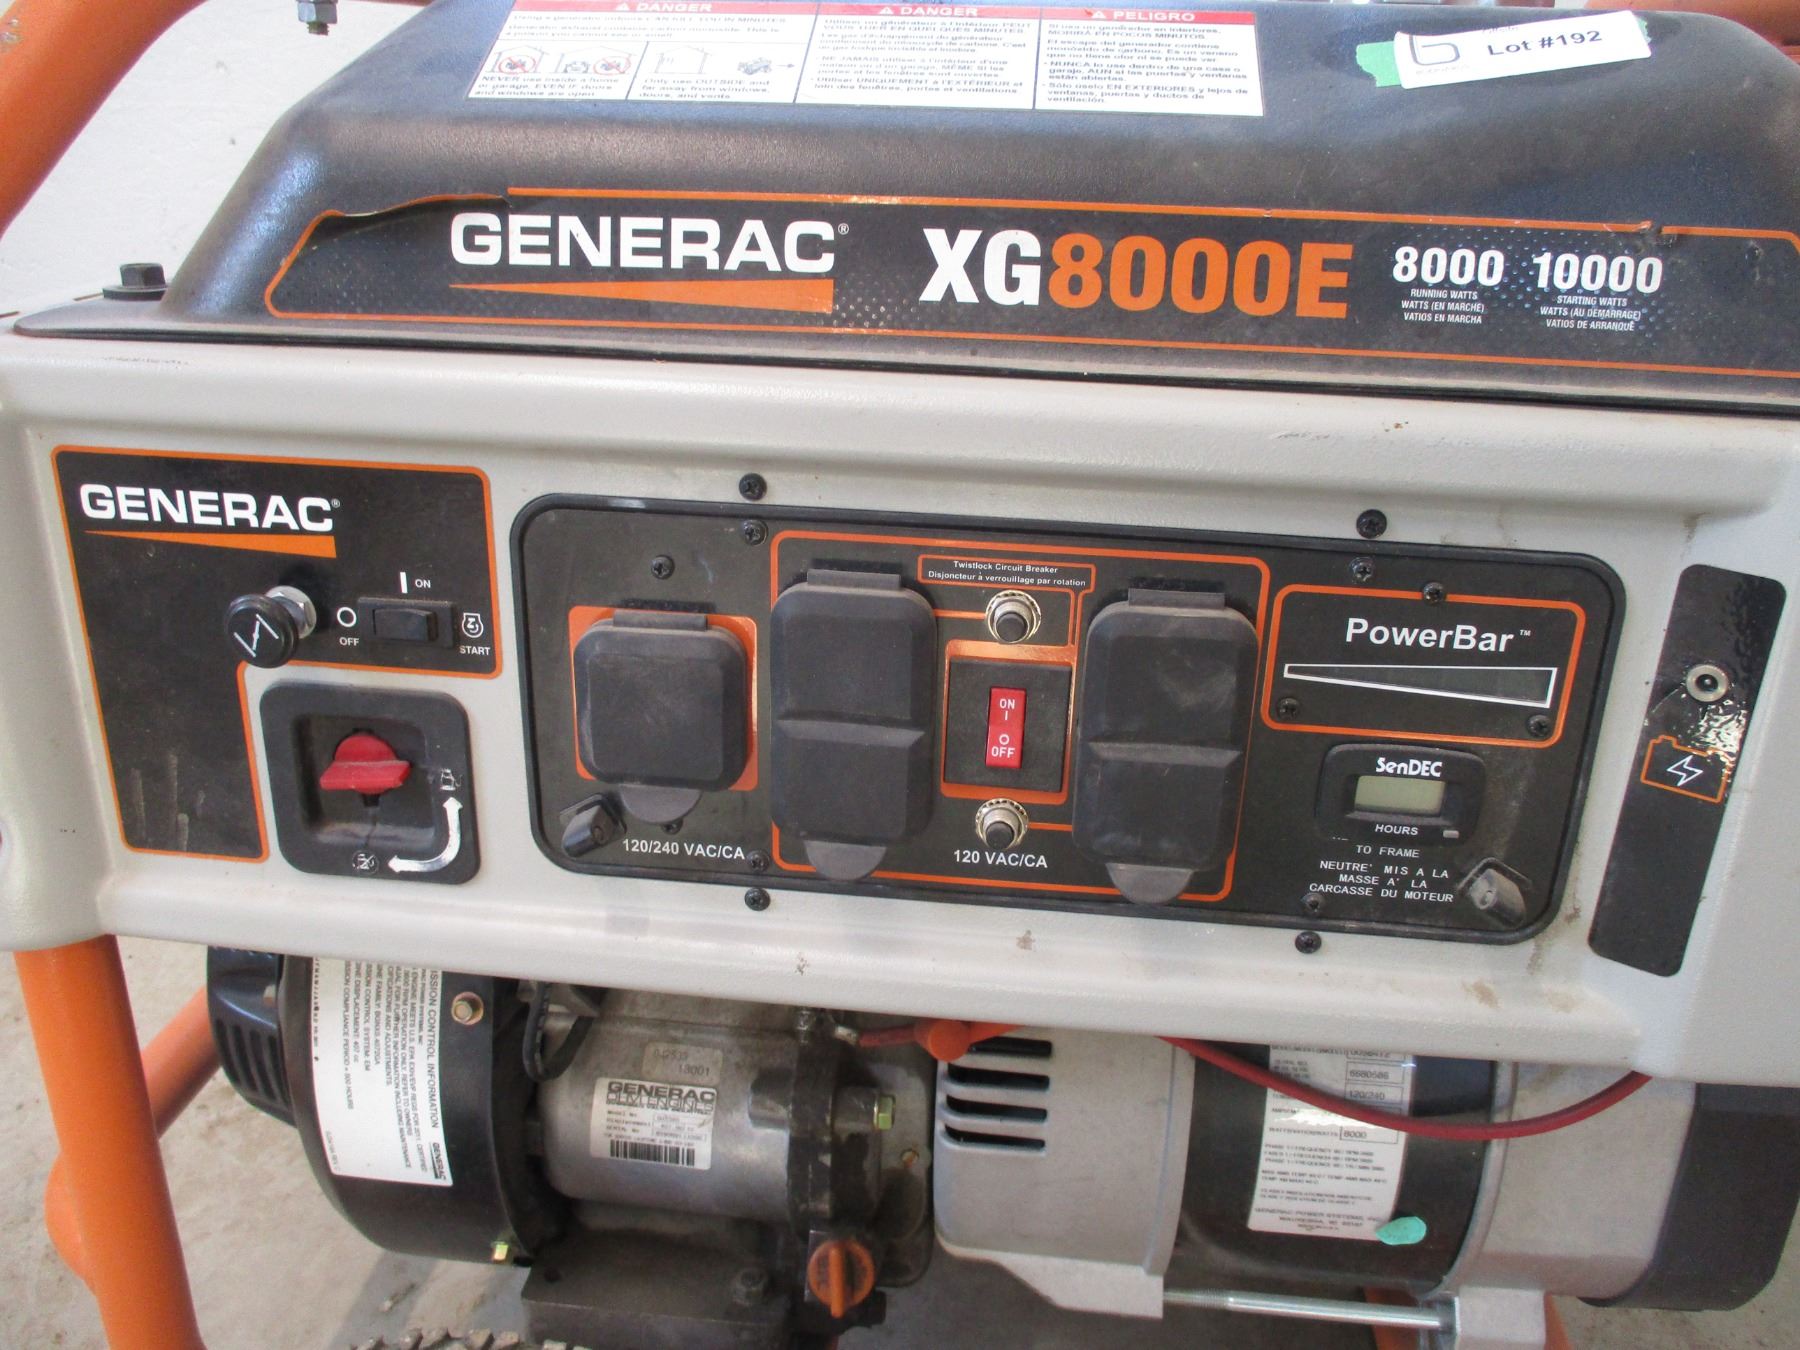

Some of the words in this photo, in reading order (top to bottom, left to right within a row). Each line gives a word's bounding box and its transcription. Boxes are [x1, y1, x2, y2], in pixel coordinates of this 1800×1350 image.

[636, 3, 713, 12] DANGER
[900, 7, 978, 16] DANGER
[1113, 12, 1195, 22] PELIGRO
[1487, 40, 1531, 56] Lot
[1539, 30, 1602, 50] #192
[919, 228, 1354, 319] XG8000E
[1392, 246, 1504, 287] 8000
[1532, 251, 1663, 293] 10000
[1410, 288, 1448, 300] RUNNING
[1449, 290, 1478, 301] WATTS
[1557, 295, 1598, 306] STARTING
[1599, 297, 1627, 307] WATTS
[1401, 300, 1430, 311] WATTS
[1431, 301, 1446, 312] (EN
[1540, 306, 1568, 317] WATTS
[1570, 307, 1586, 318] (AU
[1404, 311, 1433, 322] VATIOS
[1434, 313, 1445, 322] EN
[1446, 313, 1482, 324] MARCHA
[1546, 318, 1575, 329] VATIOS
[1577, 320, 1588, 329] DE
[953, 560, 992, 570] Twistlock
[995, 563, 1023, 572] Circuit
[1025, 564, 1058, 573] Breaker
[414, 578, 431, 589] ON
[928, 570, 976, 581] Disjoncteur
[985, 574, 1035, 584] verrouillage
[1037, 577, 1050, 586] par
[1053, 578, 1086, 587] rotation
[339, 637, 360, 647] OFF
[459, 644, 490, 656] START
[999, 698, 1015, 710] ON
[991, 746, 1015, 758] OFF
[1375, 757, 1443, 778] SenDEC
[1374, 824, 1419, 836] HOURS
[623, 838, 679, 855] 120/240
[684, 843, 745, 860] VAC/CA
[1356, 844, 1372, 854] TO
[1378, 847, 1420, 858] FRAME
[953, 850, 980, 864] 120
[984, 851, 1048, 868] VAC/CA
[1383, 866, 1408, 875] MIS
[1416, 868, 1424, 876] A
[1432, 869, 1449, 879] LA
[1339, 874, 1379, 885] MASSE
[1411, 879, 1427, 889] LA
[1309, 883, 1373, 897] CARCASSE
[1381, 889, 1397, 898] DU
[1405, 890, 1454, 902] MOTEUR
[410, 971, 418, 999] ENGINE
[428, 970, 438, 1006] ISSION
[385, 1014, 393, 1030] AND
[393, 1003, 401, 1038] FURTHER
[409, 1002, 417, 1028] MEETS
[401, 1008, 409, 1050] OPERATION
[427, 1009, 437, 1060] CONTROL
[393, 1040, 401, 1089] INFORMATION
[346, 1086, 354, 1109] HOURS
[427, 1063, 439, 1128] INFORMATION
[608, 1081, 715, 1102] GENERAC
[395, 1091, 404, 1126] INCLUDING
[403, 1098, 409, 1106] TO
[648, 1095, 713, 1113] ENGINES
[1344, 1130, 1367, 1139] 8000
[434, 1142, 446, 1181] GENERAC
